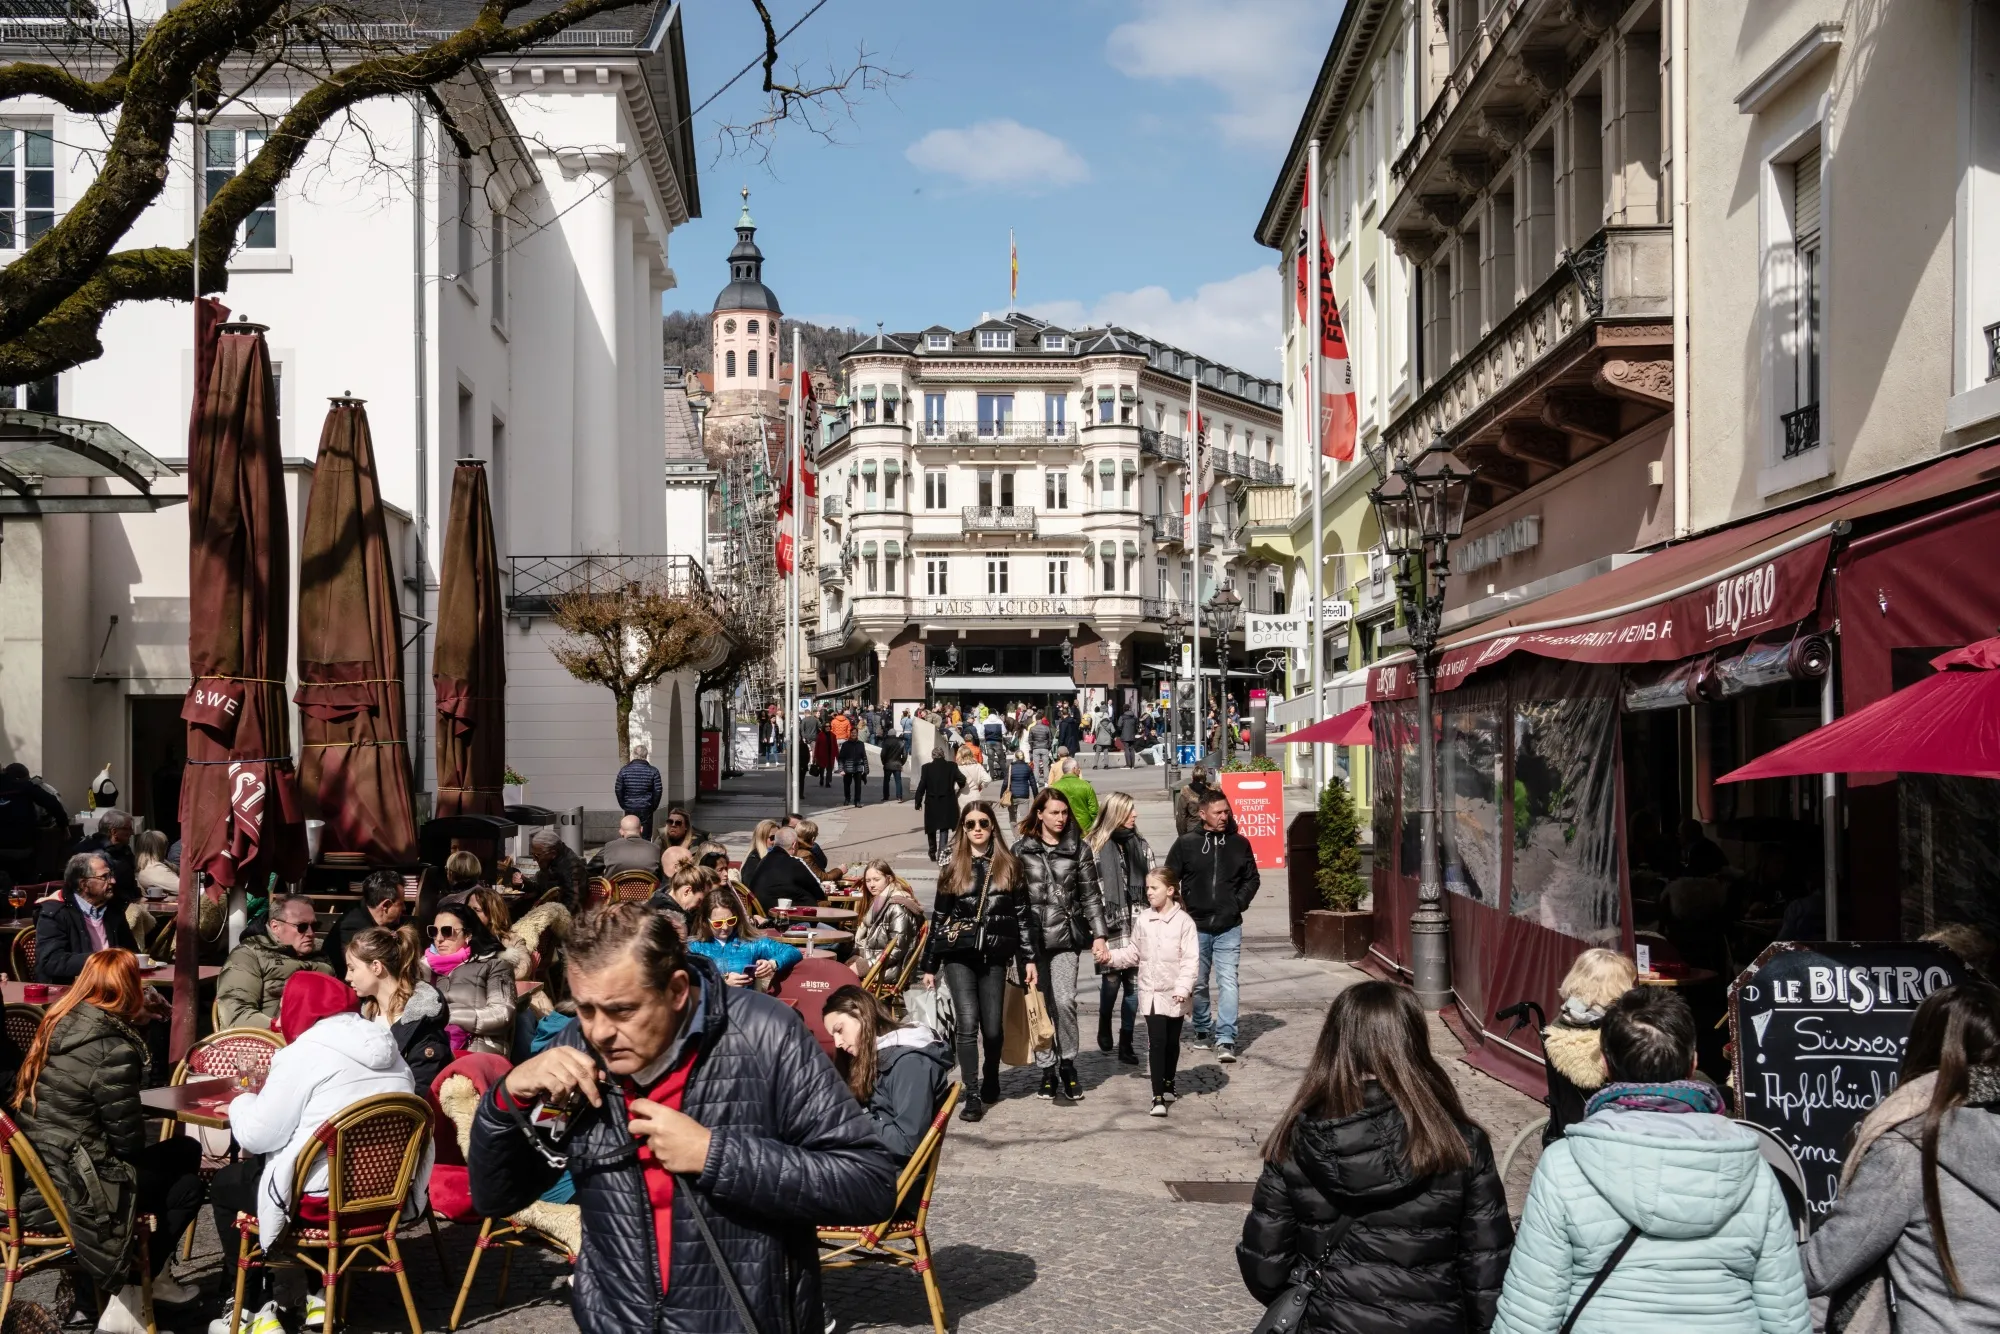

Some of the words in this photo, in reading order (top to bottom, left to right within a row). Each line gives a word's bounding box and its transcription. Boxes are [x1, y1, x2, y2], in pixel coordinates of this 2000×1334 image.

[1715, 563, 1776, 637] BISTRO
[935, 601, 972, 614] HAUS
[985, 601, 1067, 614] VICTORIA
[1253, 620, 1298, 633] Ryser
[1617, 620, 1672, 643] WEINBR
[1253, 632, 1294, 644] OPTIC
[195, 689, 206, 705] &
[207, 691, 239, 716] WE
[1241, 804, 1265, 812] STADT
[1239, 826, 1276, 837] ADEN
[806, 980, 830, 989] BISTRO
[1773, 980, 1803, 1004] LE
[1808, 966, 1952, 1015] BISTRO
